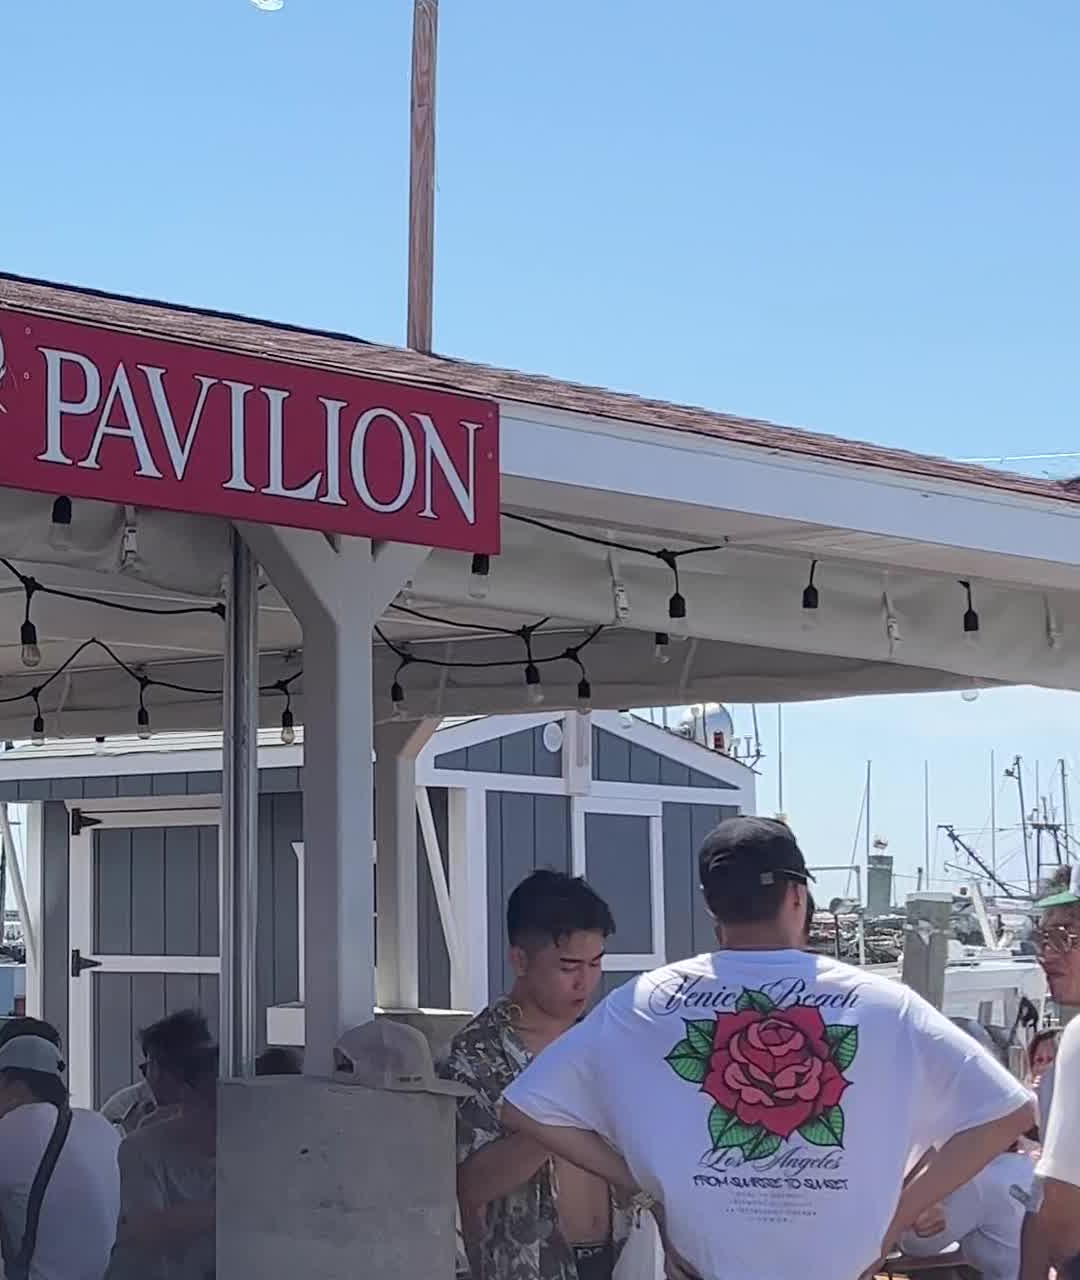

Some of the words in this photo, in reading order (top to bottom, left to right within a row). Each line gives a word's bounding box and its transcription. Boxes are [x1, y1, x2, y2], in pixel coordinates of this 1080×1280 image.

[36, 346, 484, 526] PAVILION
[649, 975, 735, 1016] Venic
[759, 976, 864, 1009] Beach
[698, 1147, 744, 1173] Los
[752, 1146, 844, 1177] Angeles
[693, 1175, 728, 1187] FROM
[784, 1178, 802, 1190] TO
